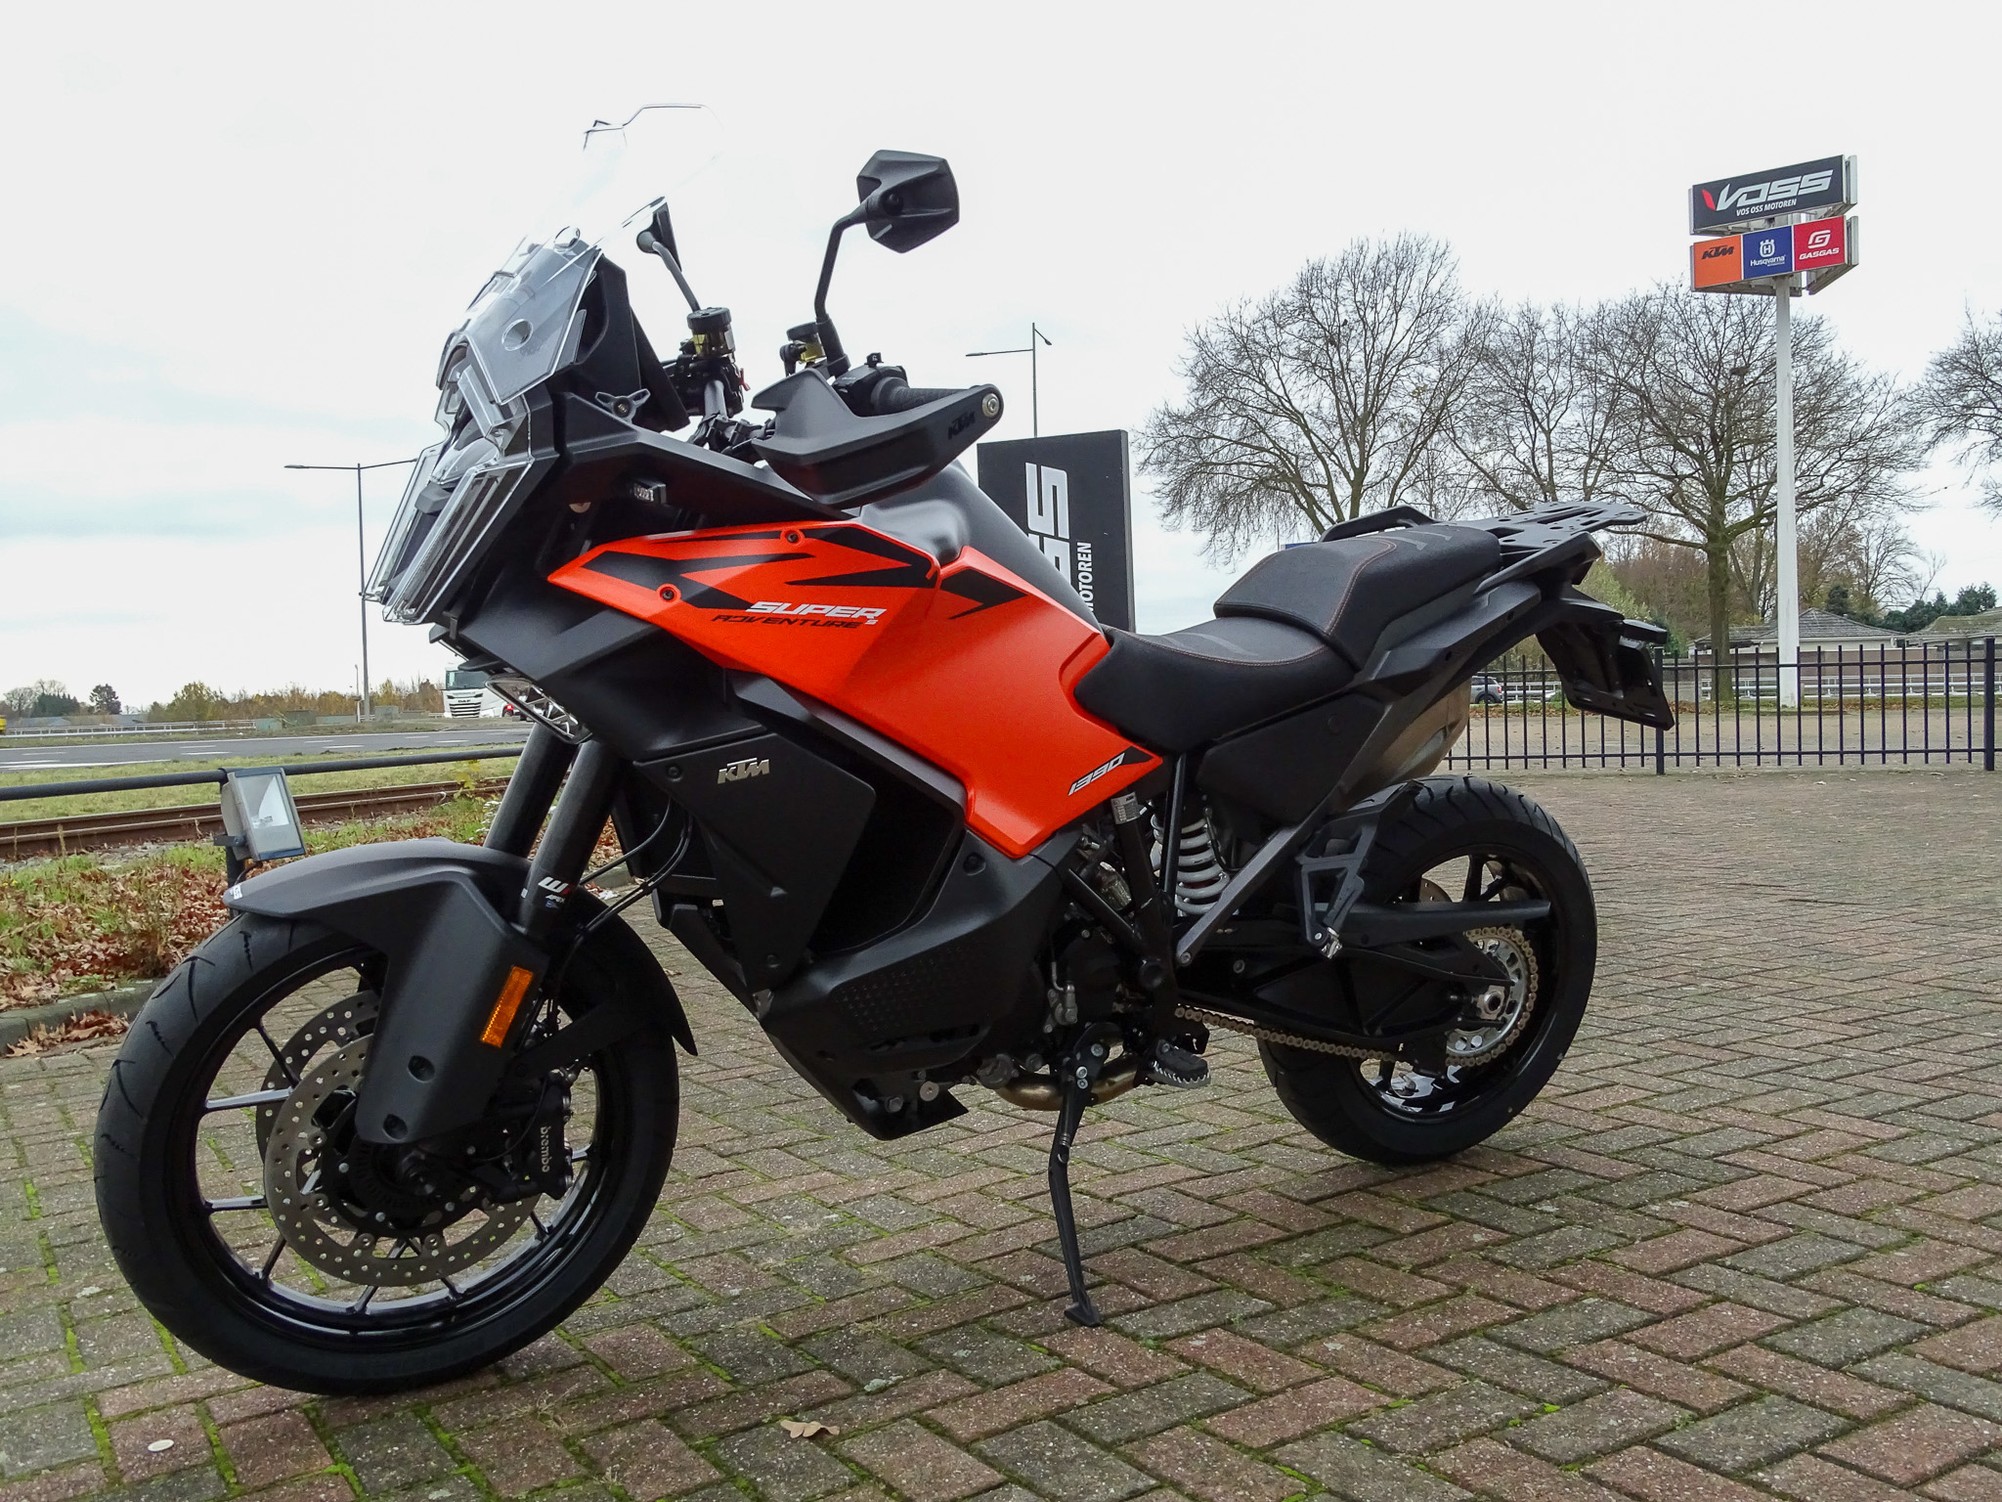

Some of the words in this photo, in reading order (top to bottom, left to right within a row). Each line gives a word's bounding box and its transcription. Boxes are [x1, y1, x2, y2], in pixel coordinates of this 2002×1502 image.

[1702, 169, 1834, 212] VOSS
[1736, 207, 1750, 217] VOS
[1750, 204, 1764, 214] OSS
[1764, 198, 1797, 212] MOTOREN
[1701, 244, 1735, 260] KTM
[1750, 255, 1785, 267] Husqvarna
[1799, 247, 1840, 260] GASGAS
[948, 411, 976, 440] KTM
[745, 600, 887, 619] SUPER
[711, 614, 864, 629] ADVENTURE
[717, 757, 770, 784] KTM
[1067, 752, 1126, 797] 1390
[540, 1126, 552, 1173] brembo
